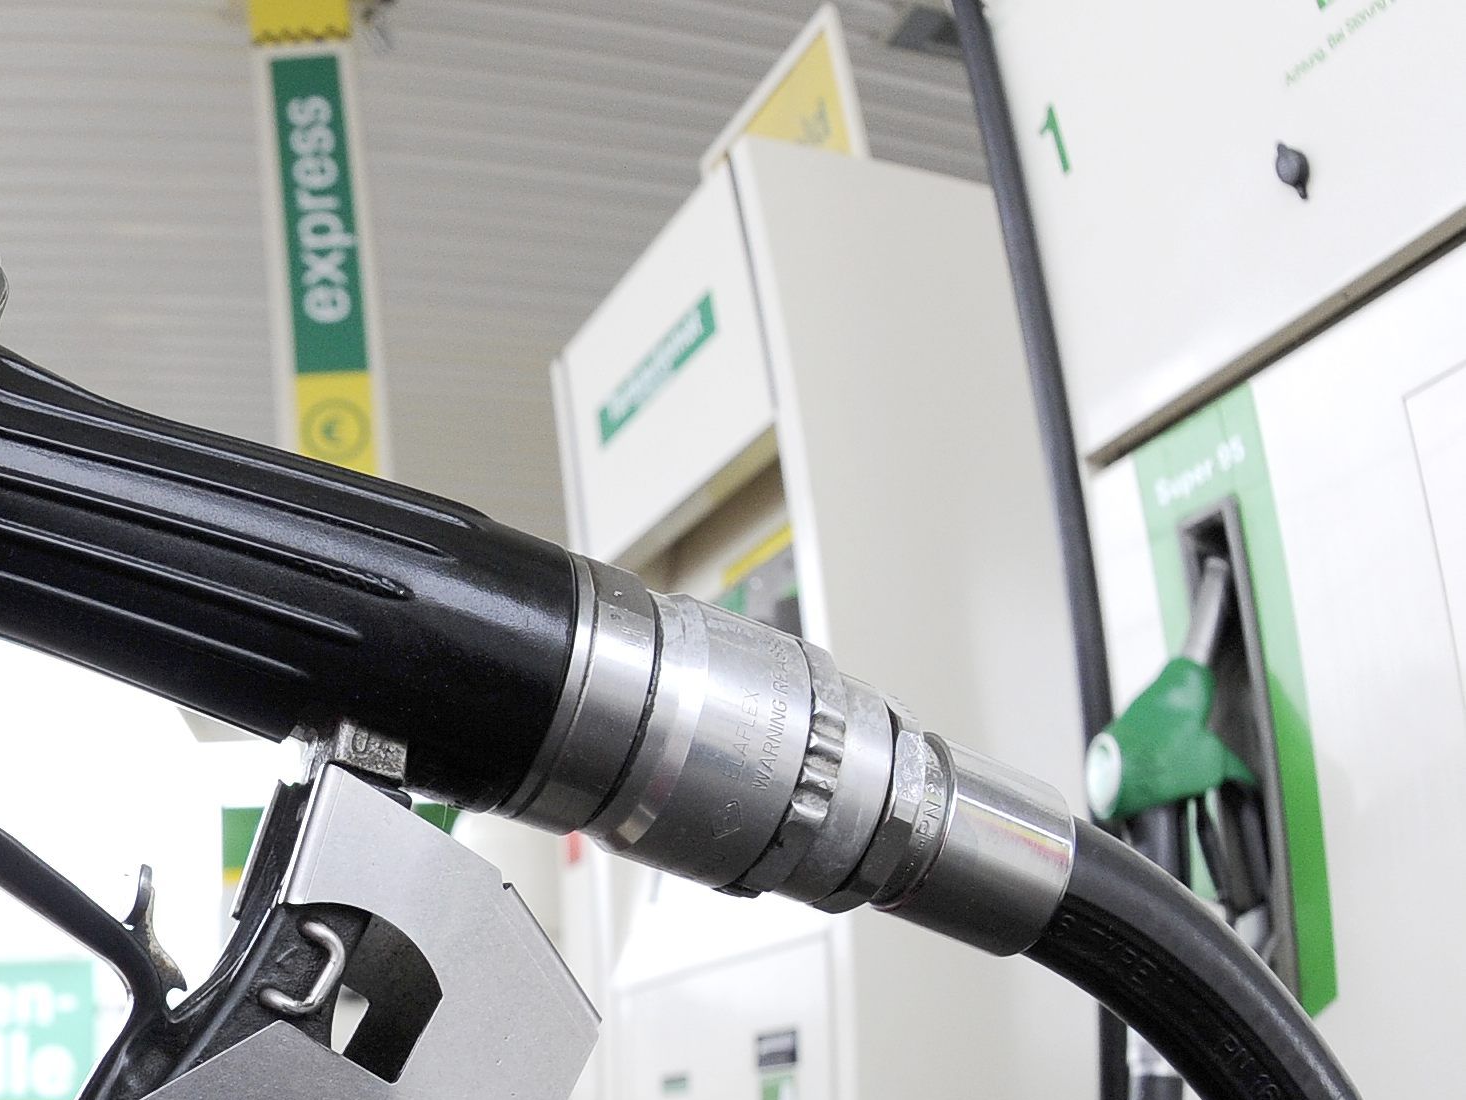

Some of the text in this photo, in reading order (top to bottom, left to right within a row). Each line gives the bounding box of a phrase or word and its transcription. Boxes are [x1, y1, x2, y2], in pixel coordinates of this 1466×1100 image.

[1040, 102, 1071, 174] 1
[286, 95, 358, 325] express
[722, 686, 760, 782] ELAFLEX
[751, 698, 788, 791] WARNING
